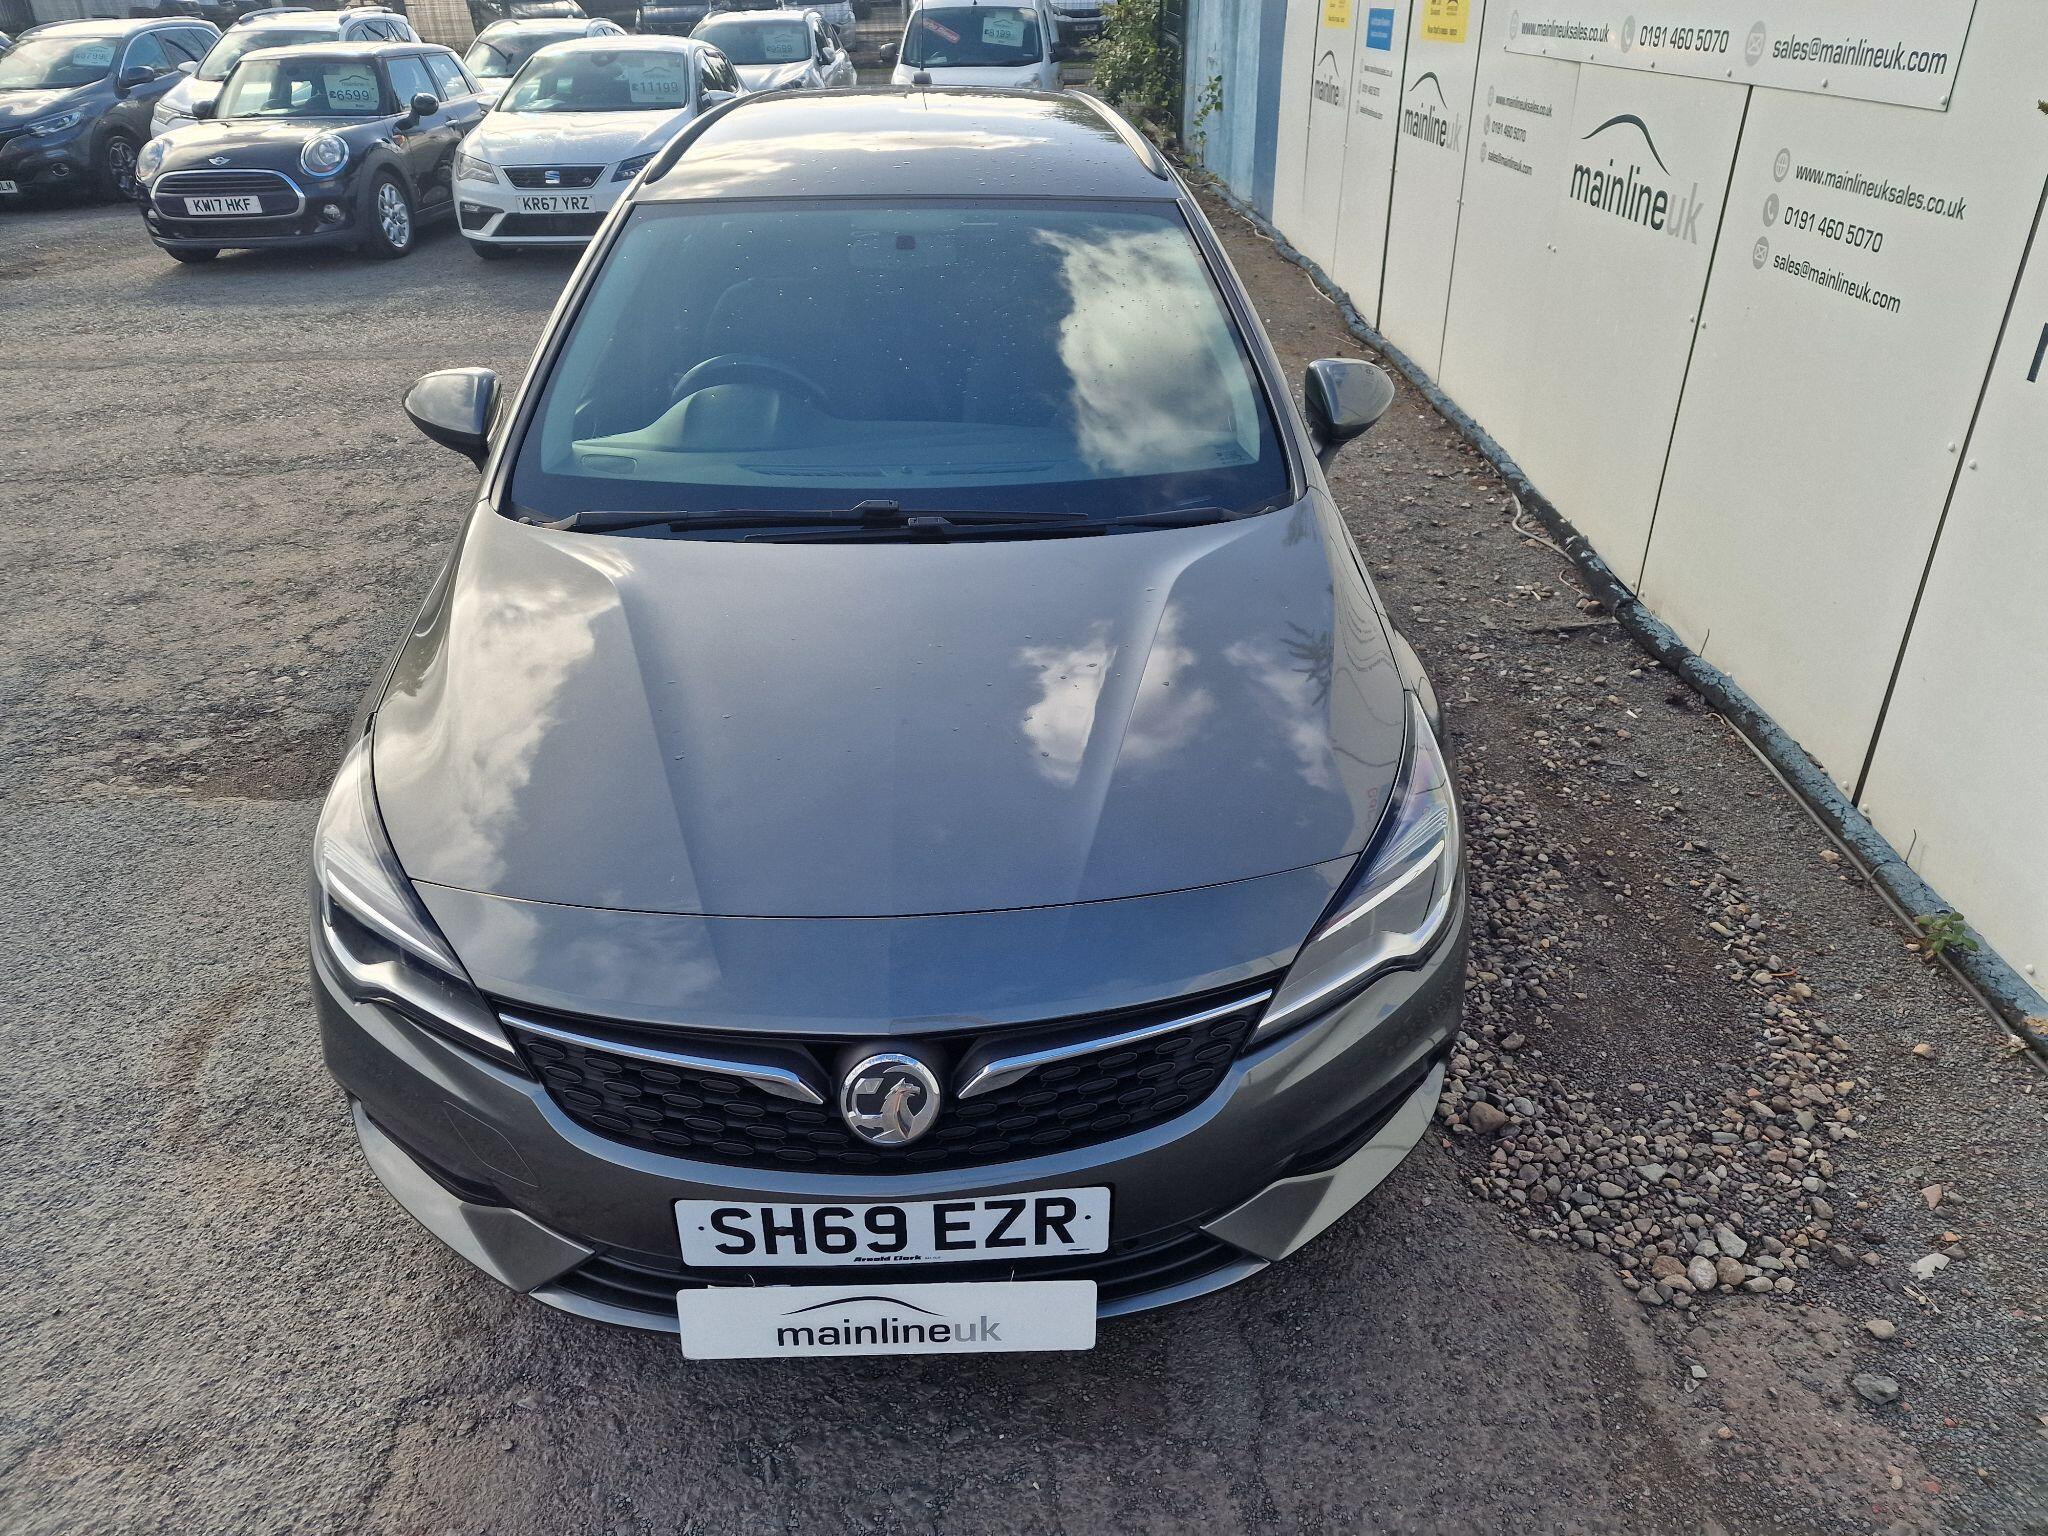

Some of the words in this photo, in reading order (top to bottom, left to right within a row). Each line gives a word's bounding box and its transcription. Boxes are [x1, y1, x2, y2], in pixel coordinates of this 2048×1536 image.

[1521, 19, 1610, 43] www.mainlineuksales.co.uk
[1639, 25, 1668, 48] 0191
[1669, 27, 1694, 51] 460
[1695, 29, 1730, 54] 5070
[1772, 34, 1948, 75] sales@mainlineuk.com
[1403, 102, 1462, 153] mainlineuk
[193, 199, 222, 212] KW17
[225, 198, 251, 211] HKF
[522, 196, 558, 210] KR67
[562, 196, 590, 210] YRZ
[1570, 158, 1705, 245] mainlineuk
[1795, 164, 1968, 220] www.mainlineuksales.co.uk
[1784, 206, 1816, 232] 0191
[1817, 216, 1845, 242] 460
[1845, 225, 1884, 253] 5070
[1773, 254, 1902, 314] sales@mainlineuk.com
[709, 1204, 909, 1256] SH69
[932, 1196, 1078, 1252] EZR
[777, 1315, 1002, 1348] mainlineuk
